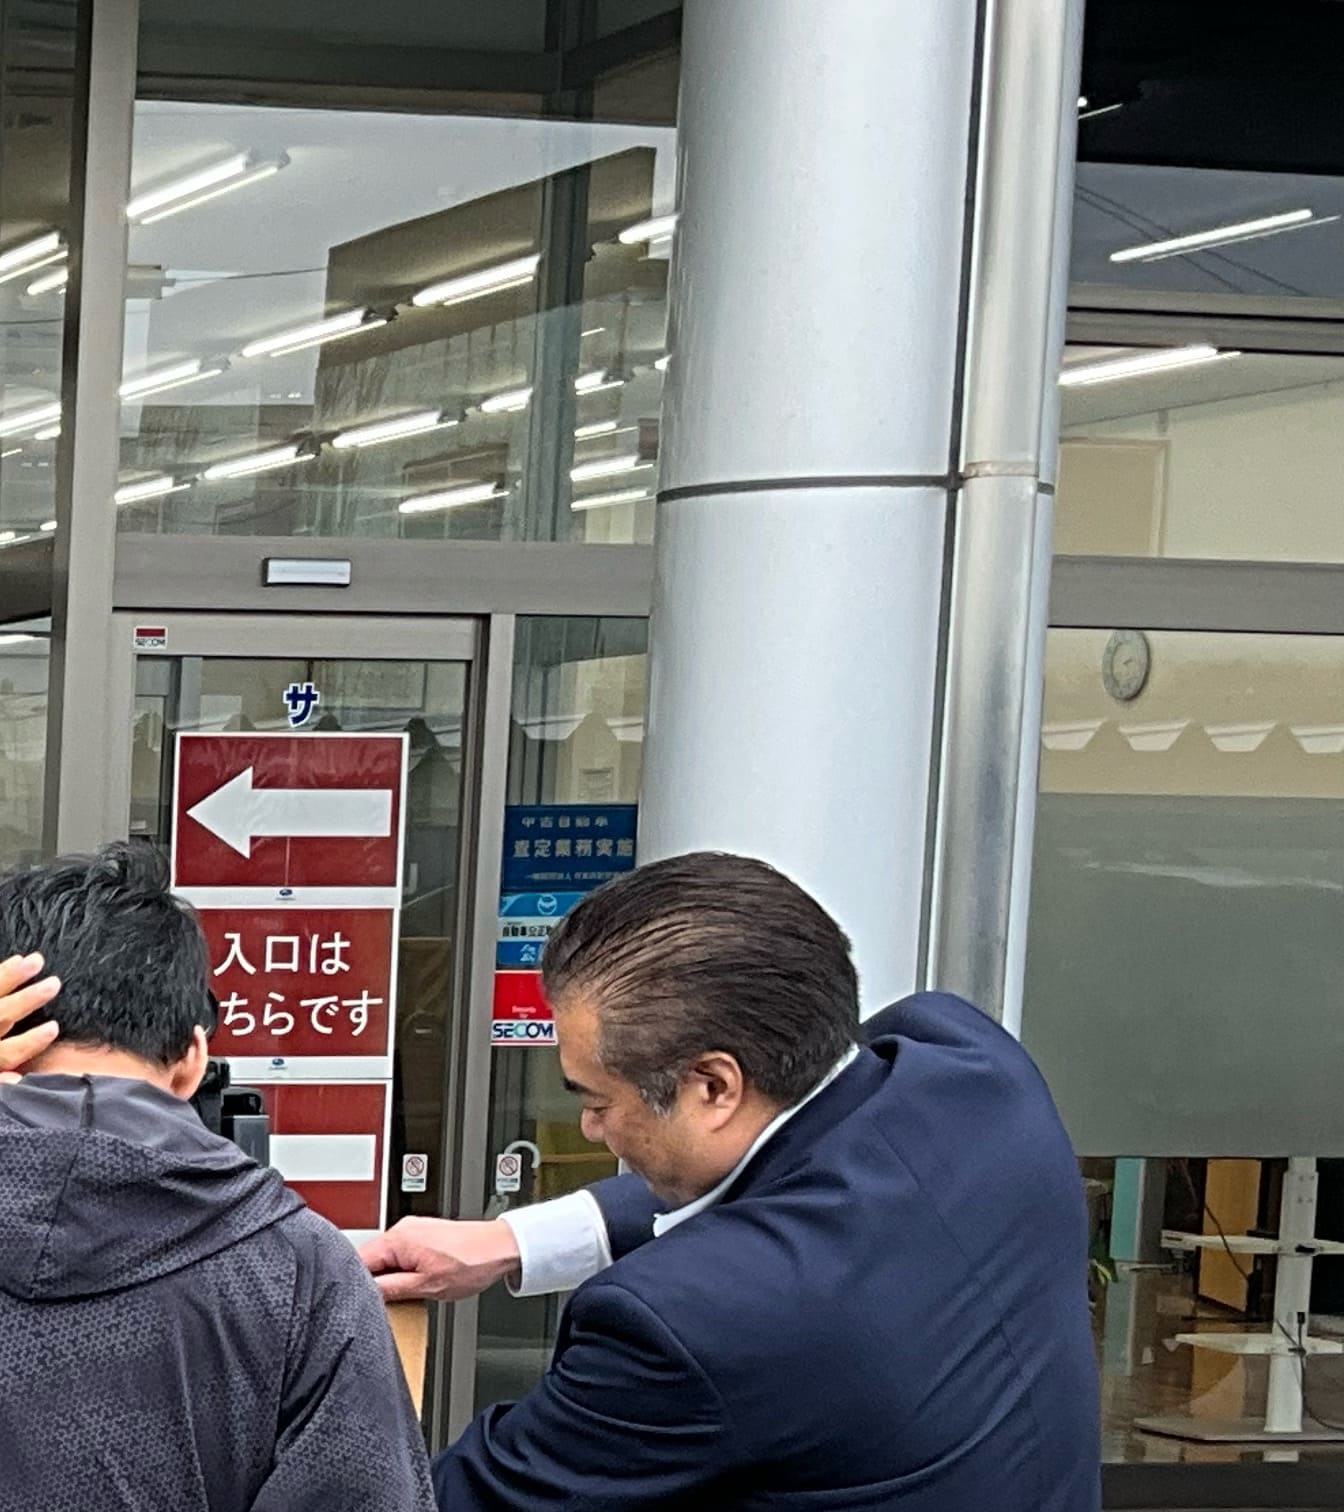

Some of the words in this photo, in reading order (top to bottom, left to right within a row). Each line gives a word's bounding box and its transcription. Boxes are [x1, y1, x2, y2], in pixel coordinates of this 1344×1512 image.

[284, 684, 318, 726] サ
[213, 931, 351, 977] 入口は
[219, 990, 383, 1036] ちらです
[493, 1022, 554, 1038] SECOM
